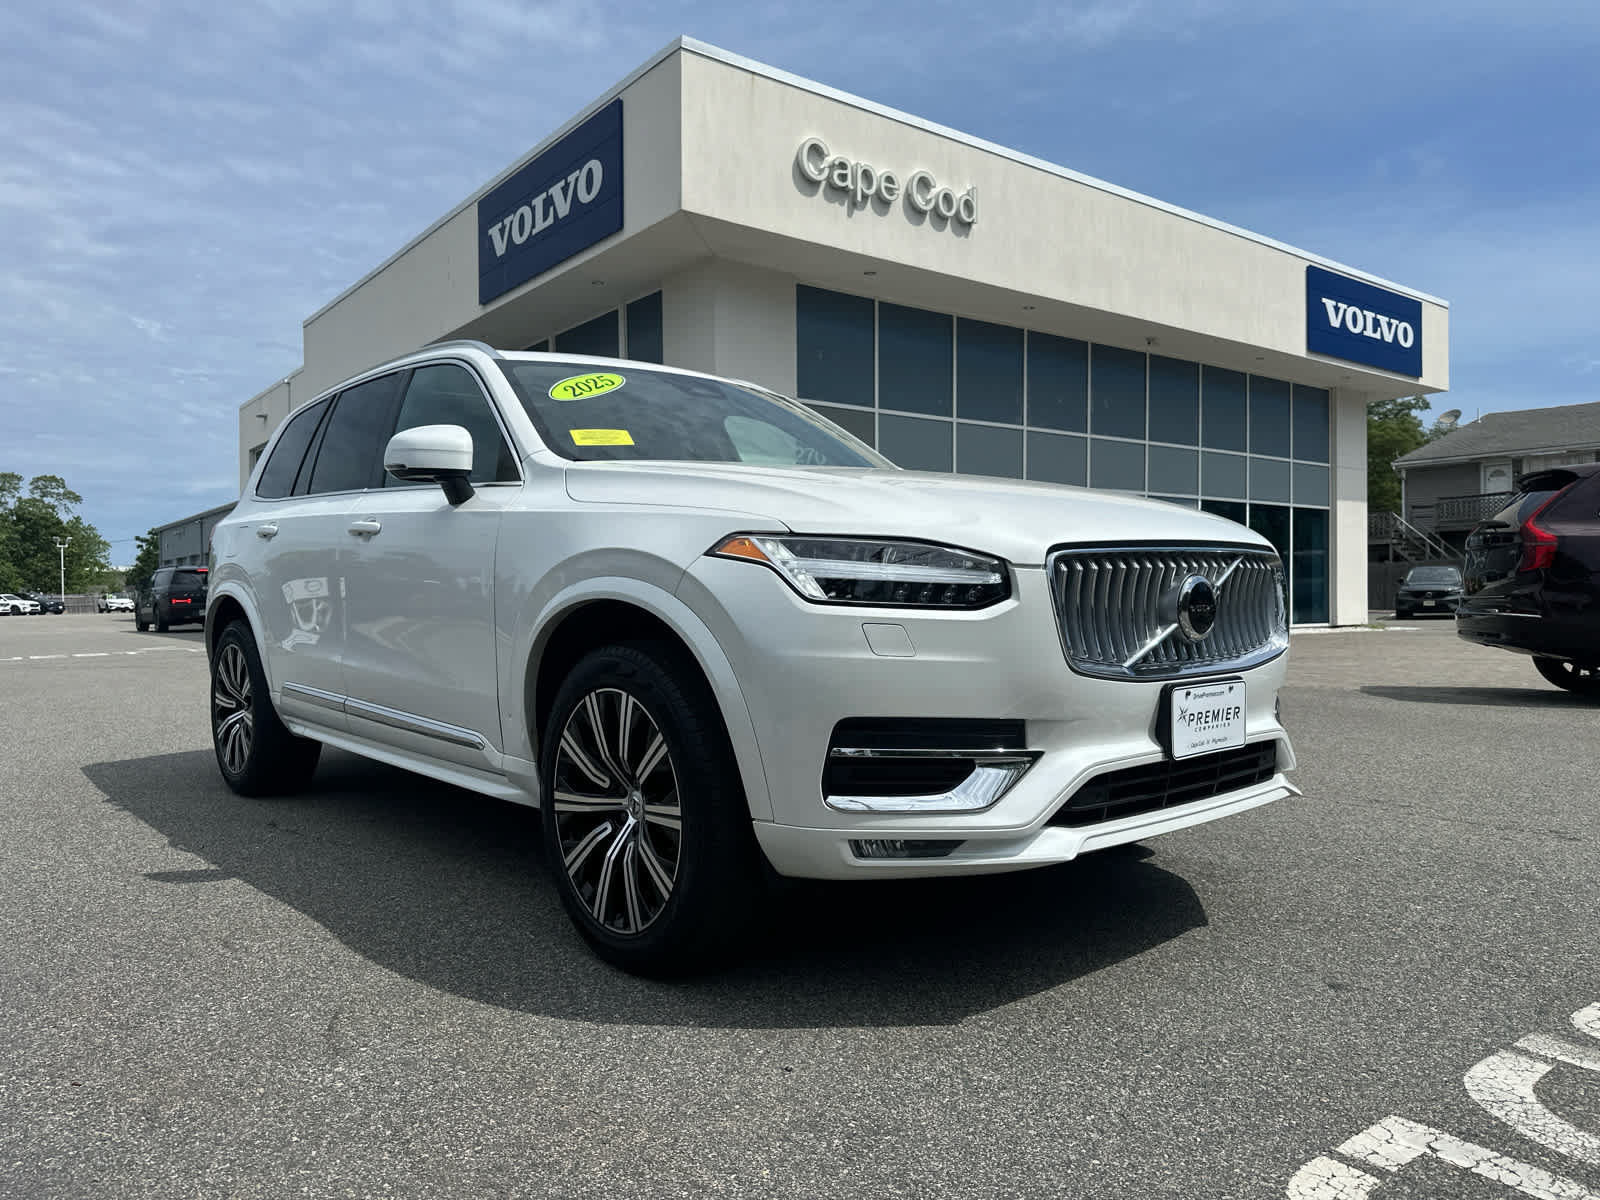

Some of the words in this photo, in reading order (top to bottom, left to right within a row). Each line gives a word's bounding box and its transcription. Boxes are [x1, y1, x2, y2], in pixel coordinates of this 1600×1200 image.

[800, 137, 899, 202] Cape
[908, 170, 977, 224] Cod
[488, 159, 603, 257] VOLVO
[1321, 297, 1414, 348] VOLVO
[563, 375, 615, 397] 2025
[1187, 706, 1241, 727] PREMIER
